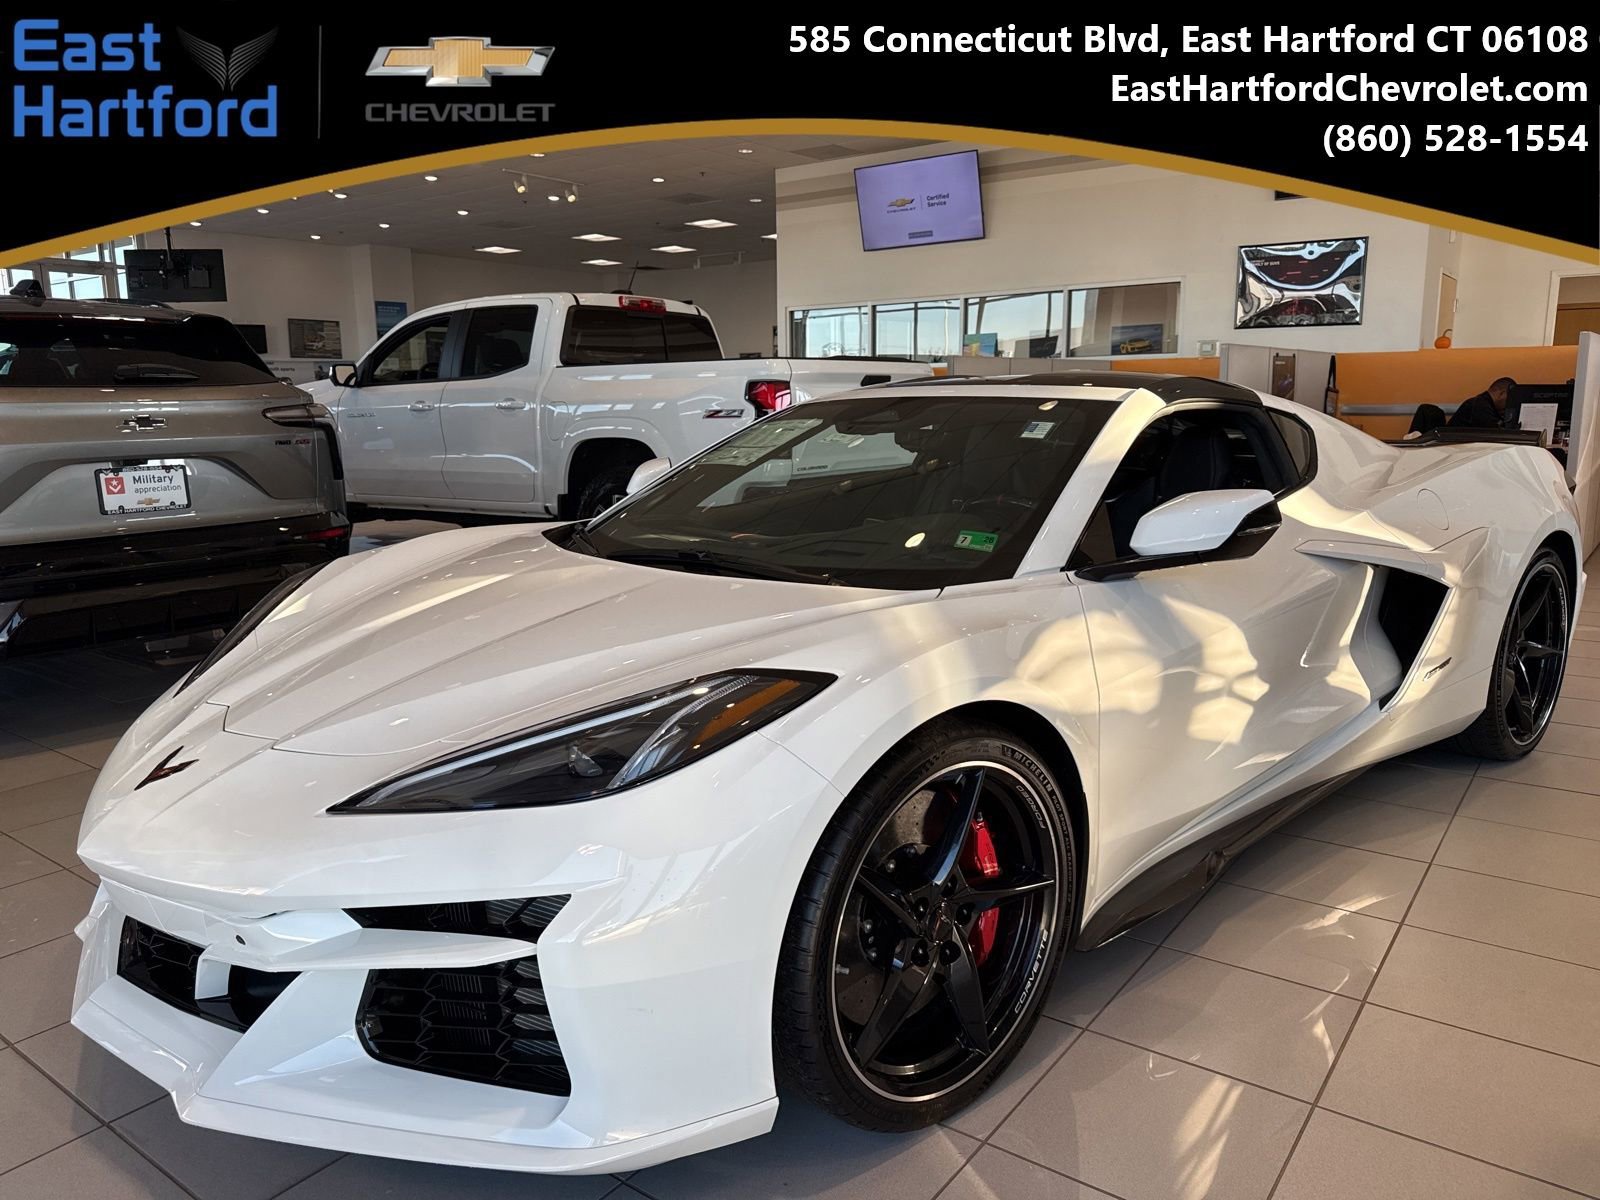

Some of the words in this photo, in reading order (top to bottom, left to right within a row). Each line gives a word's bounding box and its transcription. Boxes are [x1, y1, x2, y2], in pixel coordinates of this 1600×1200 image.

[926, 193, 950, 201] Certified
[927, 200, 947, 208] Service
[132, 475, 174, 485] Military
[134, 484, 181, 494] appreciation
[960, 536, 968, 544] 7
[1013, 750, 1053, 792] MICHELIN
[1016, 784, 1047, 829] FORGED
[1014, 928, 1049, 1014] CORVETTE
